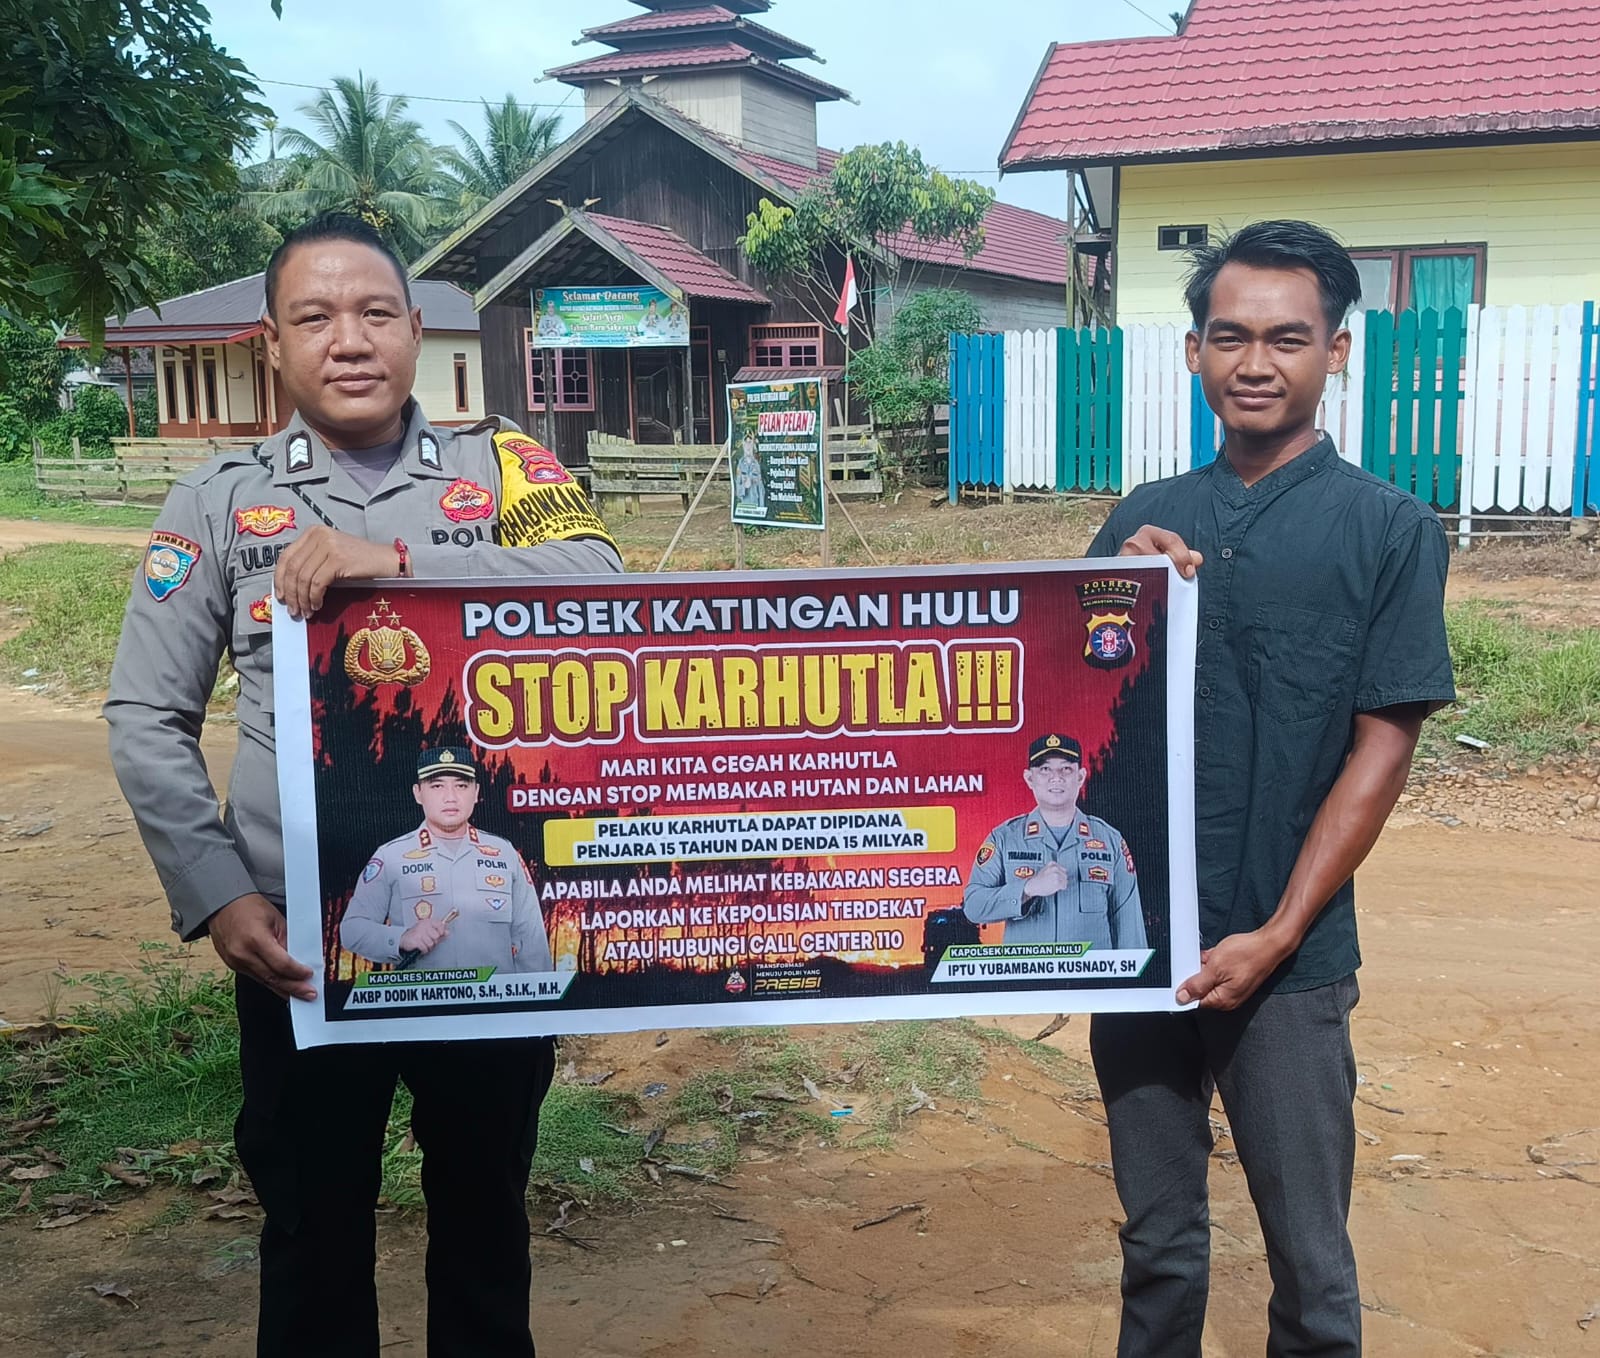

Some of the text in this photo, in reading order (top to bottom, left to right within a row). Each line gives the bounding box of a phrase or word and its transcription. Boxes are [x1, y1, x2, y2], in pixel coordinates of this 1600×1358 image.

[562, 290, 640, 303] Selamat Datang
[759, 413, 781, 433] PELAN
[783, 412, 809, 432] PELAN
[431, 523, 501, 548] POL
[1084, 580, 1132, 590] POLRES
[464, 589, 1019, 637] POLSEK KATINGAN HULU
[475, 650, 1012, 738] STOP KARHUTLA !!!
[601, 751, 898, 778] MARI KITA CEGAH KARHUTLA
[512, 774, 983, 808] DENGAN STOP MEMBAKAR HUTAN DAN LAHAN
[598, 813, 903, 838] PELAKU KARHUTLA DAPAT DIPIDANA
[577, 833, 924, 859] PENJARA 15 TAHUN DAN DENDA 15 MILYAR
[1081, 851, 1112, 862] POLRI
[402, 862, 434, 875] DODIK
[477, 859, 507, 870] POLRI
[541, 867, 961, 900] APABILA ANDA MELIHAT KEBAKARAN SEGERA
[581, 899, 925, 930] LAPORKAN KE KEPOLISIAN TERDEKAT
[604, 931, 903, 961] ATAU HUBUNGI CALL CENTER 110
[950, 944, 1081, 957] KAPOLSEK KATINGAN HULU
[369, 970, 477, 984] KAPOLRES KATINGAN
[948, 960, 1136, 977] IPTU YUBAMBANG KUSNADY, SH
[352, 989, 381, 1004] AKBP
[385, 988, 419, 1002] DODIK
[421, 986, 476, 1000] HARTONO,
[479, 985, 503, 999] S.H.,
[538, 982, 561, 996] M.H.
[754, 976, 822, 991] PRESISI
